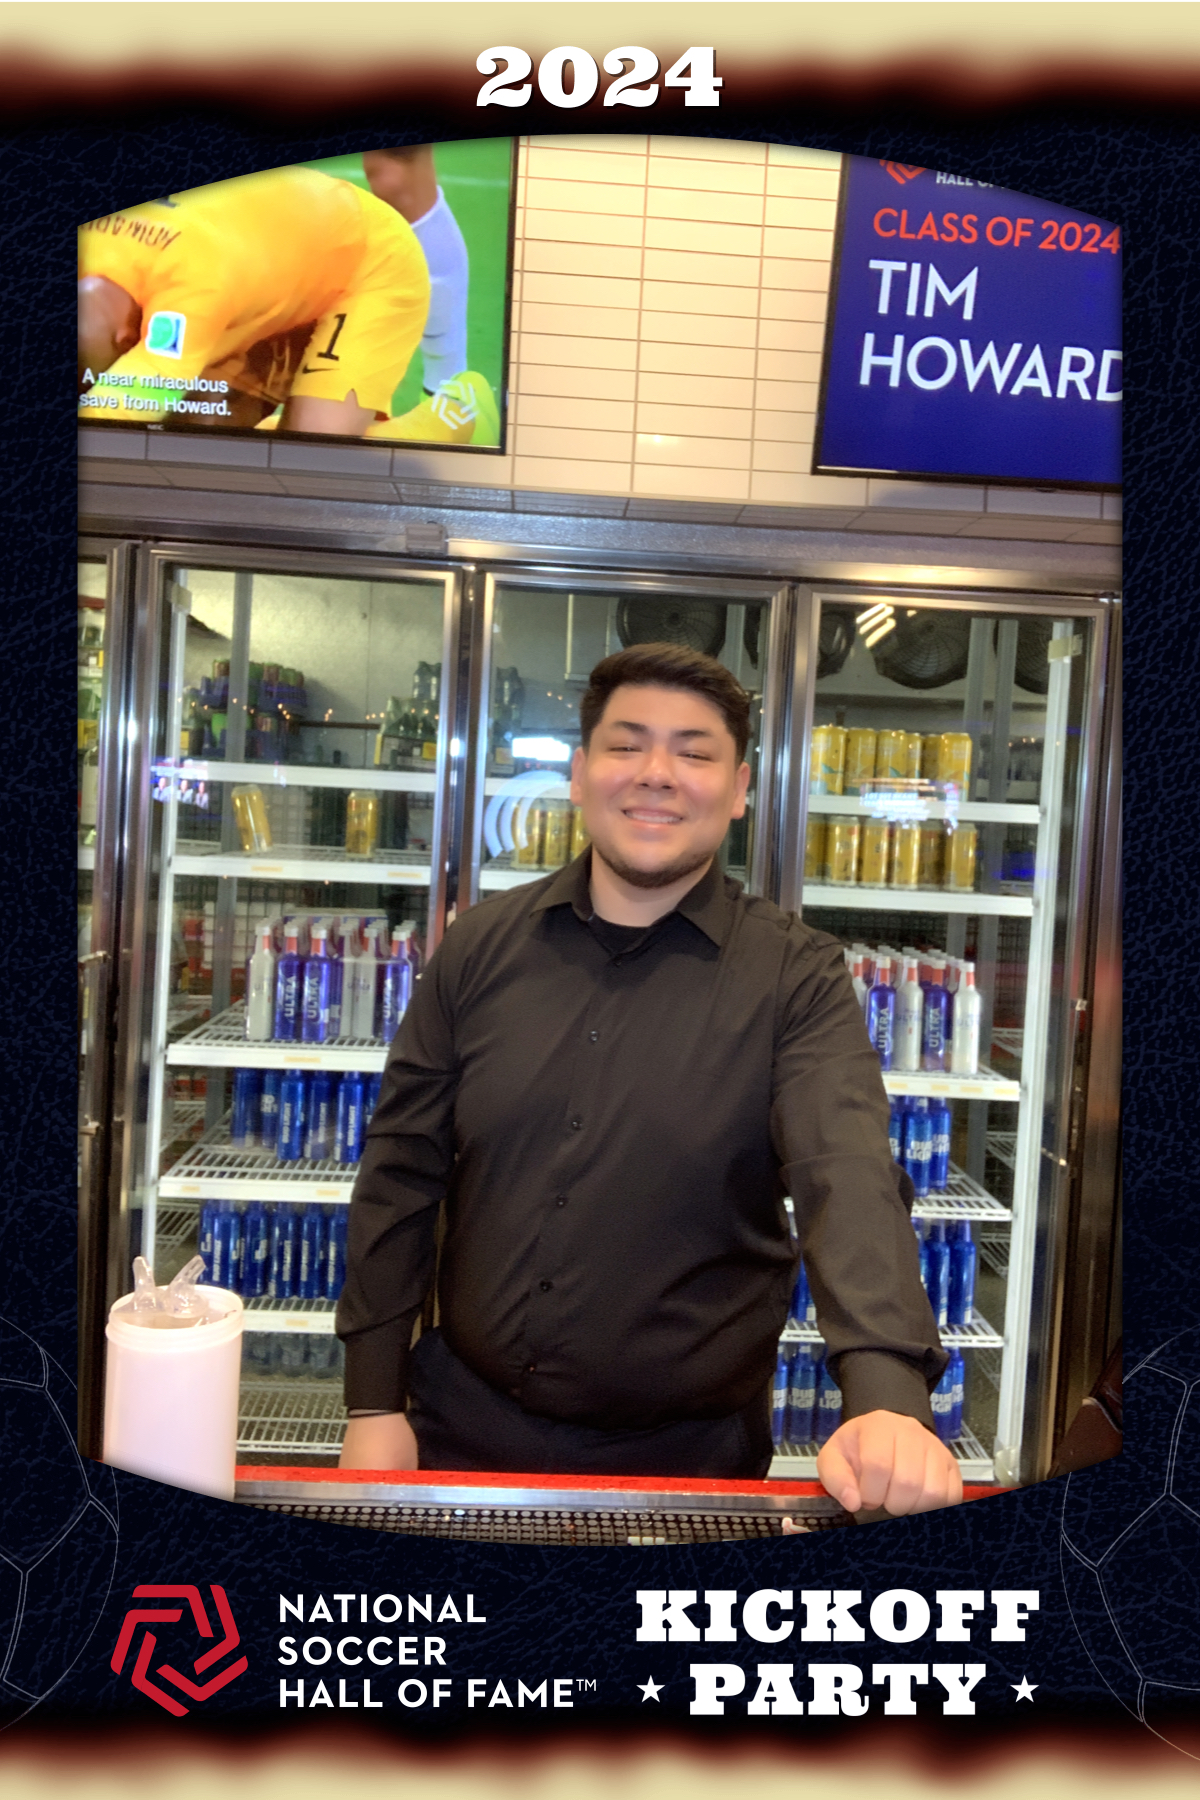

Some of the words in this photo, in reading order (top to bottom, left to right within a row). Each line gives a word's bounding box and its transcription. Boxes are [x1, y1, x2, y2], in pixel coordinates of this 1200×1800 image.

[873, 207, 978, 244] CLASS
[985, 216, 1035, 248] OF
[1038, 219, 1122, 255] 2024
[868, 259, 979, 321] TIM
[316, 312, 347, 361] 1
[81, 367, 96, 384] A
[98, 371, 136, 388] near
[140, 374, 229, 393] miraculous
[859, 331, 1123, 402] HOWARD
[79, 393, 118, 408] save
[123, 394, 160, 411] from
[164, 397, 232, 417] Howard.
[878, 1007, 890, 1049] ULTRA
[929, 1007, 941, 1048] ULTRA
